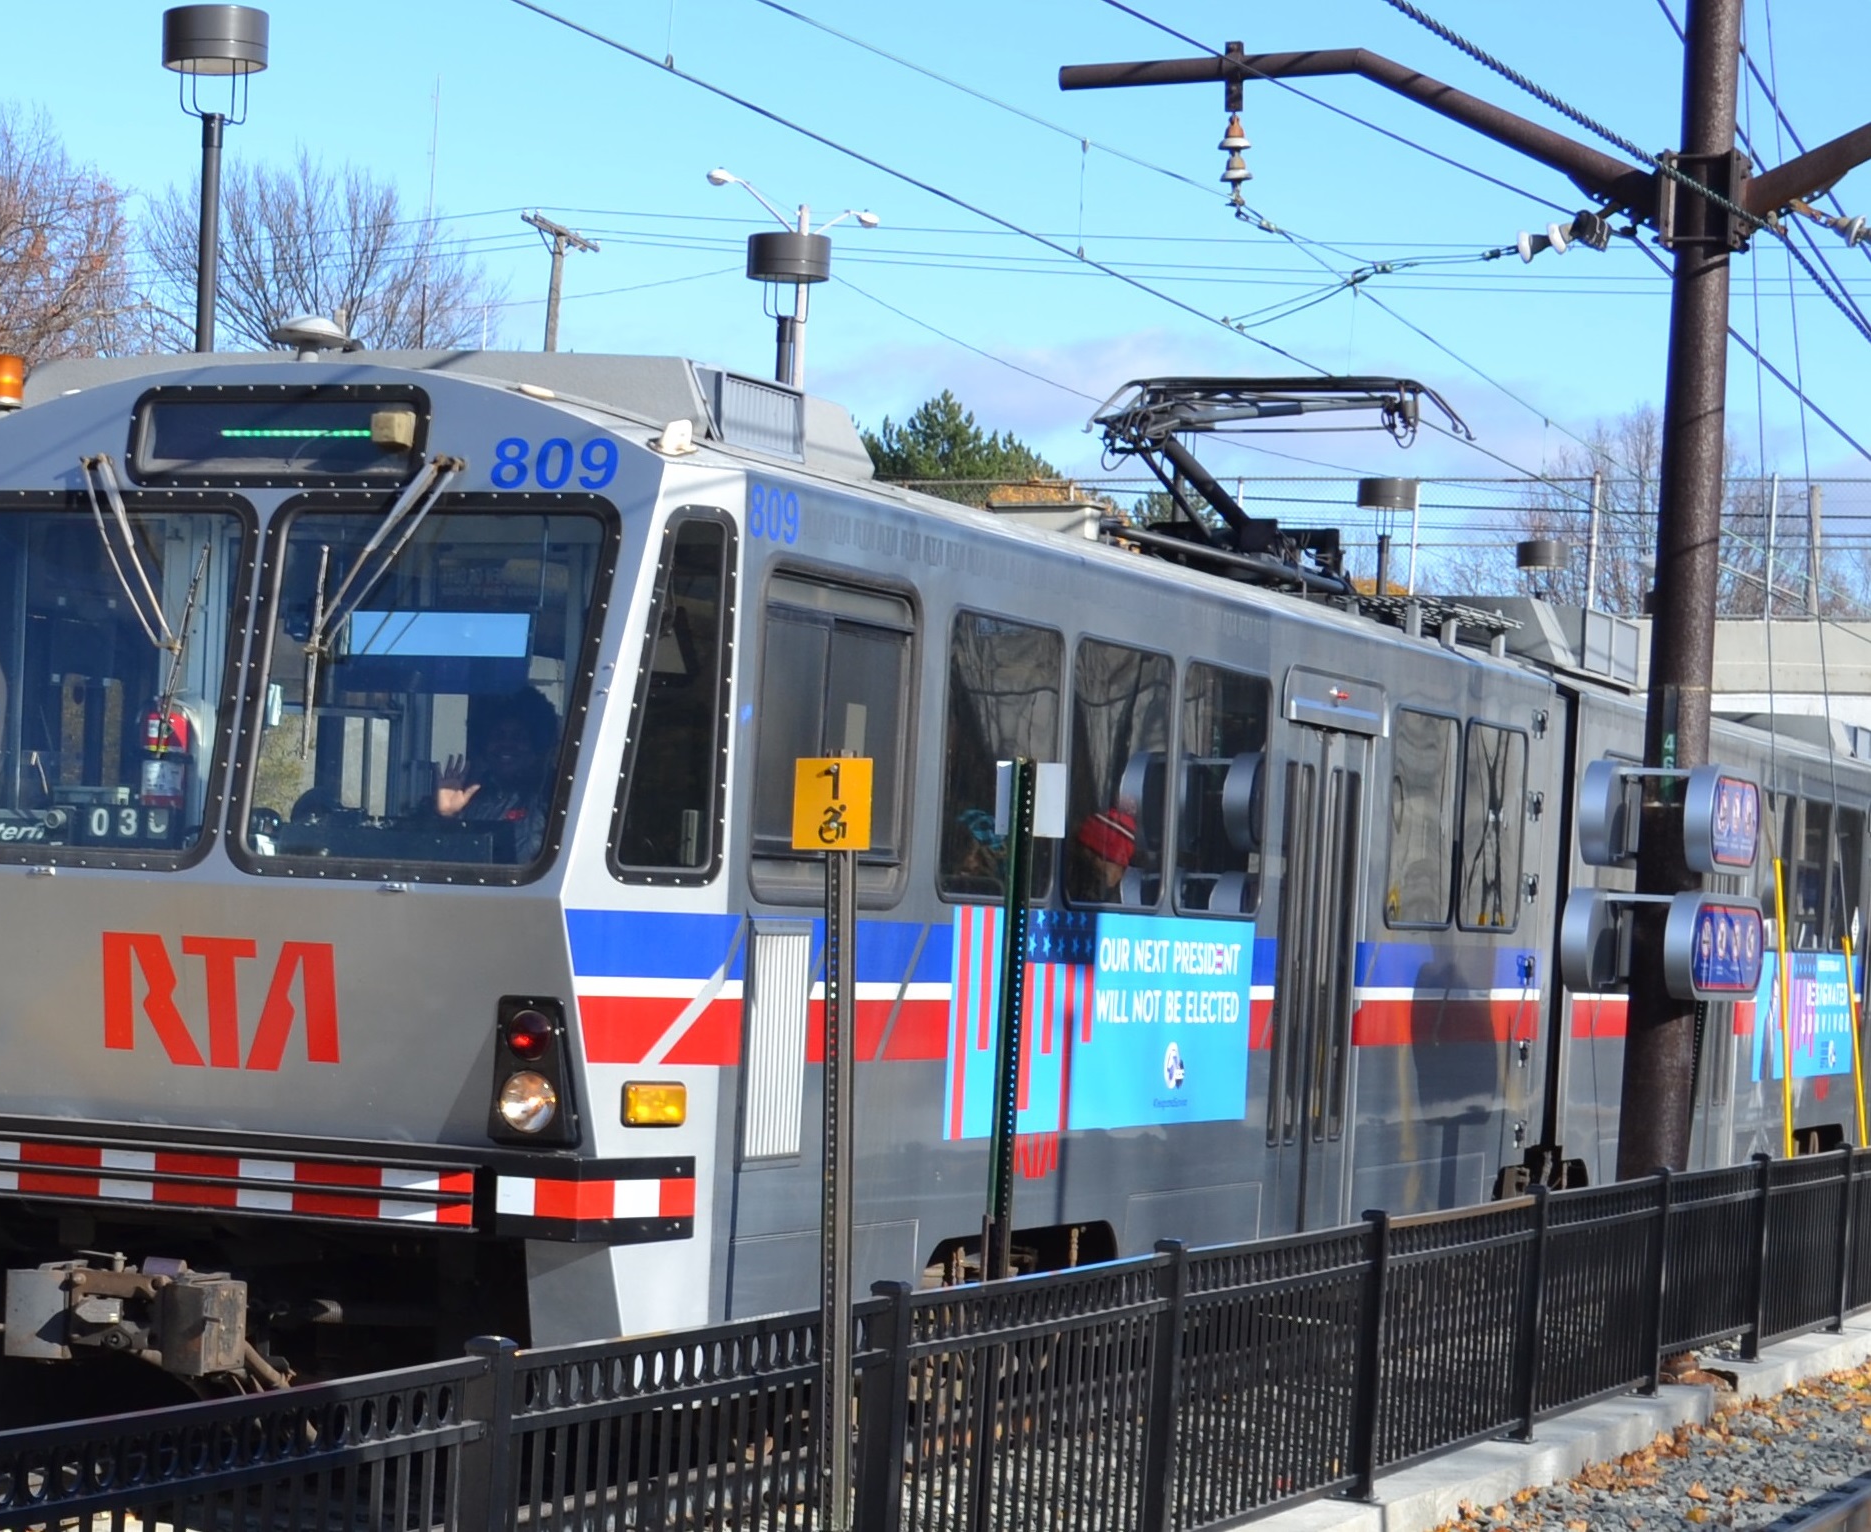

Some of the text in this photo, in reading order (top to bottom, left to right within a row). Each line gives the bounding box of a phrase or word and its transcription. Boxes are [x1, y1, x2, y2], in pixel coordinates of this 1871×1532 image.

[490, 437, 619, 489] 809
[749, 484, 800, 544] 809
[1099, 937, 1242, 976] OUR NEXT PRESIDENT
[102, 931, 340, 1072] RTA
[1095, 989, 1240, 1024] WILL NOT BE ELECTED
